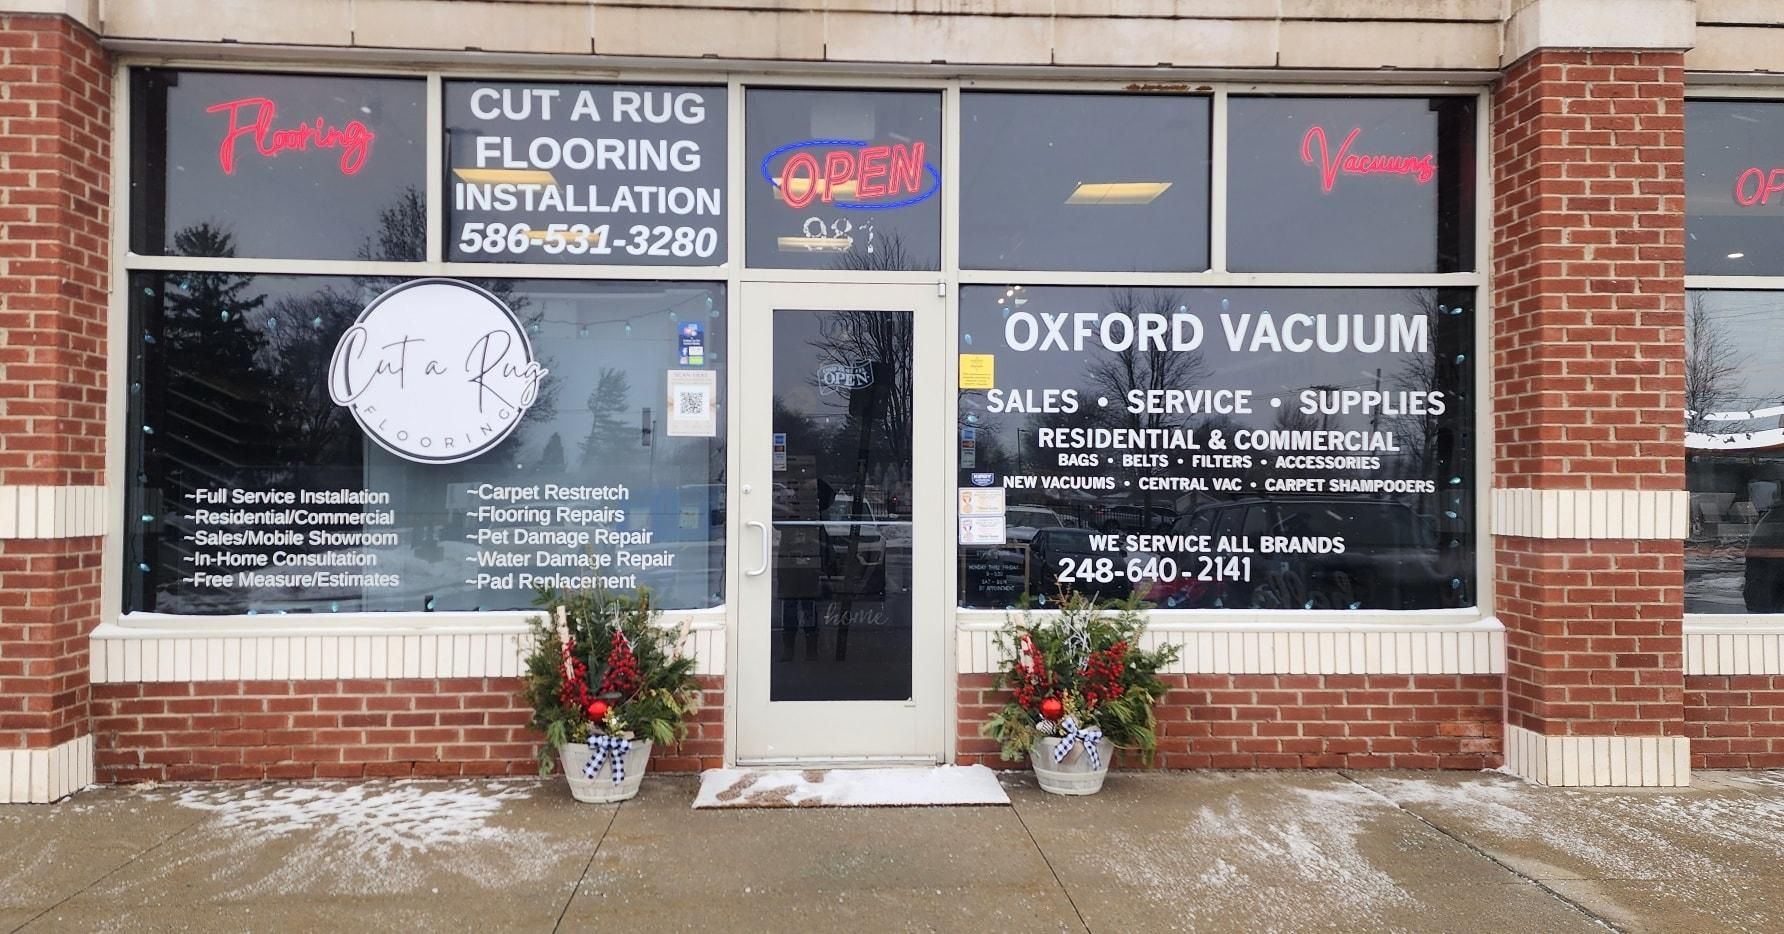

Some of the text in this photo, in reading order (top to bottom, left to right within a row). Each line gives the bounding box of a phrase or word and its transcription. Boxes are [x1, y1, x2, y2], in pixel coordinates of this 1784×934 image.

[470, 87, 705, 124] CUT A RUG
[207, 97, 375, 175] Flooring
[476, 136, 700, 172] FLOORING
[1303, 126, 1435, 192] Vacuums
[781, 141, 926, 208] OPEN
[456, 183, 720, 215] INSTALLATION
[459, 223, 717, 257] 586-531-3280
[1005, 311, 1428, 353] OXFORD VACUUM
[332, 326, 546, 414] Cut a Rug
[824, 372, 868, 386] OPEN
[987, 389, 1446, 416] SALES SERVICE SUPPLIES
[363, 405, 511, 449] FLOORING
[1038, 428, 1400, 452] RESIDENTIAL & COMMERCIAL
[1058, 453, 1381, 470] BAGS BELTS FILTERS ACCESSORIES
[466, 484, 629, 503] ~Carpet Restretch
[1003, 475, 1037, 489] NEW
[1041, 476, 1115, 490] VACUUMS
[1138, 476, 1208, 491] CENTRAL
[1212, 478, 1242, 491] VAC
[1265, 478, 1327, 492] CARPET
[1329, 479, 1435, 493] SHAMPOOERS
[231, 488, 295, 504] Service
[300, 489, 390, 504] Installation
[184, 509, 394, 525] ~Residential/Commercial
[466, 506, 625, 526] ~Flooring Repairs
[184, 530, 398, 545] ~Sales/Mobile Showroom
[514, 529, 589, 548] Damage
[595, 529, 653, 548] Repair
[1089, 535, 1345, 554] WE SERVICE ALL BRANDS
[183, 551, 377, 566] ~In-Home Consultation
[465, 551, 675, 570] ~Water Damage Repair
[238, 572, 400, 587] Measure/Estimates
[519, 573, 636, 592] Replacement
[825, 603, 889, 625] home
